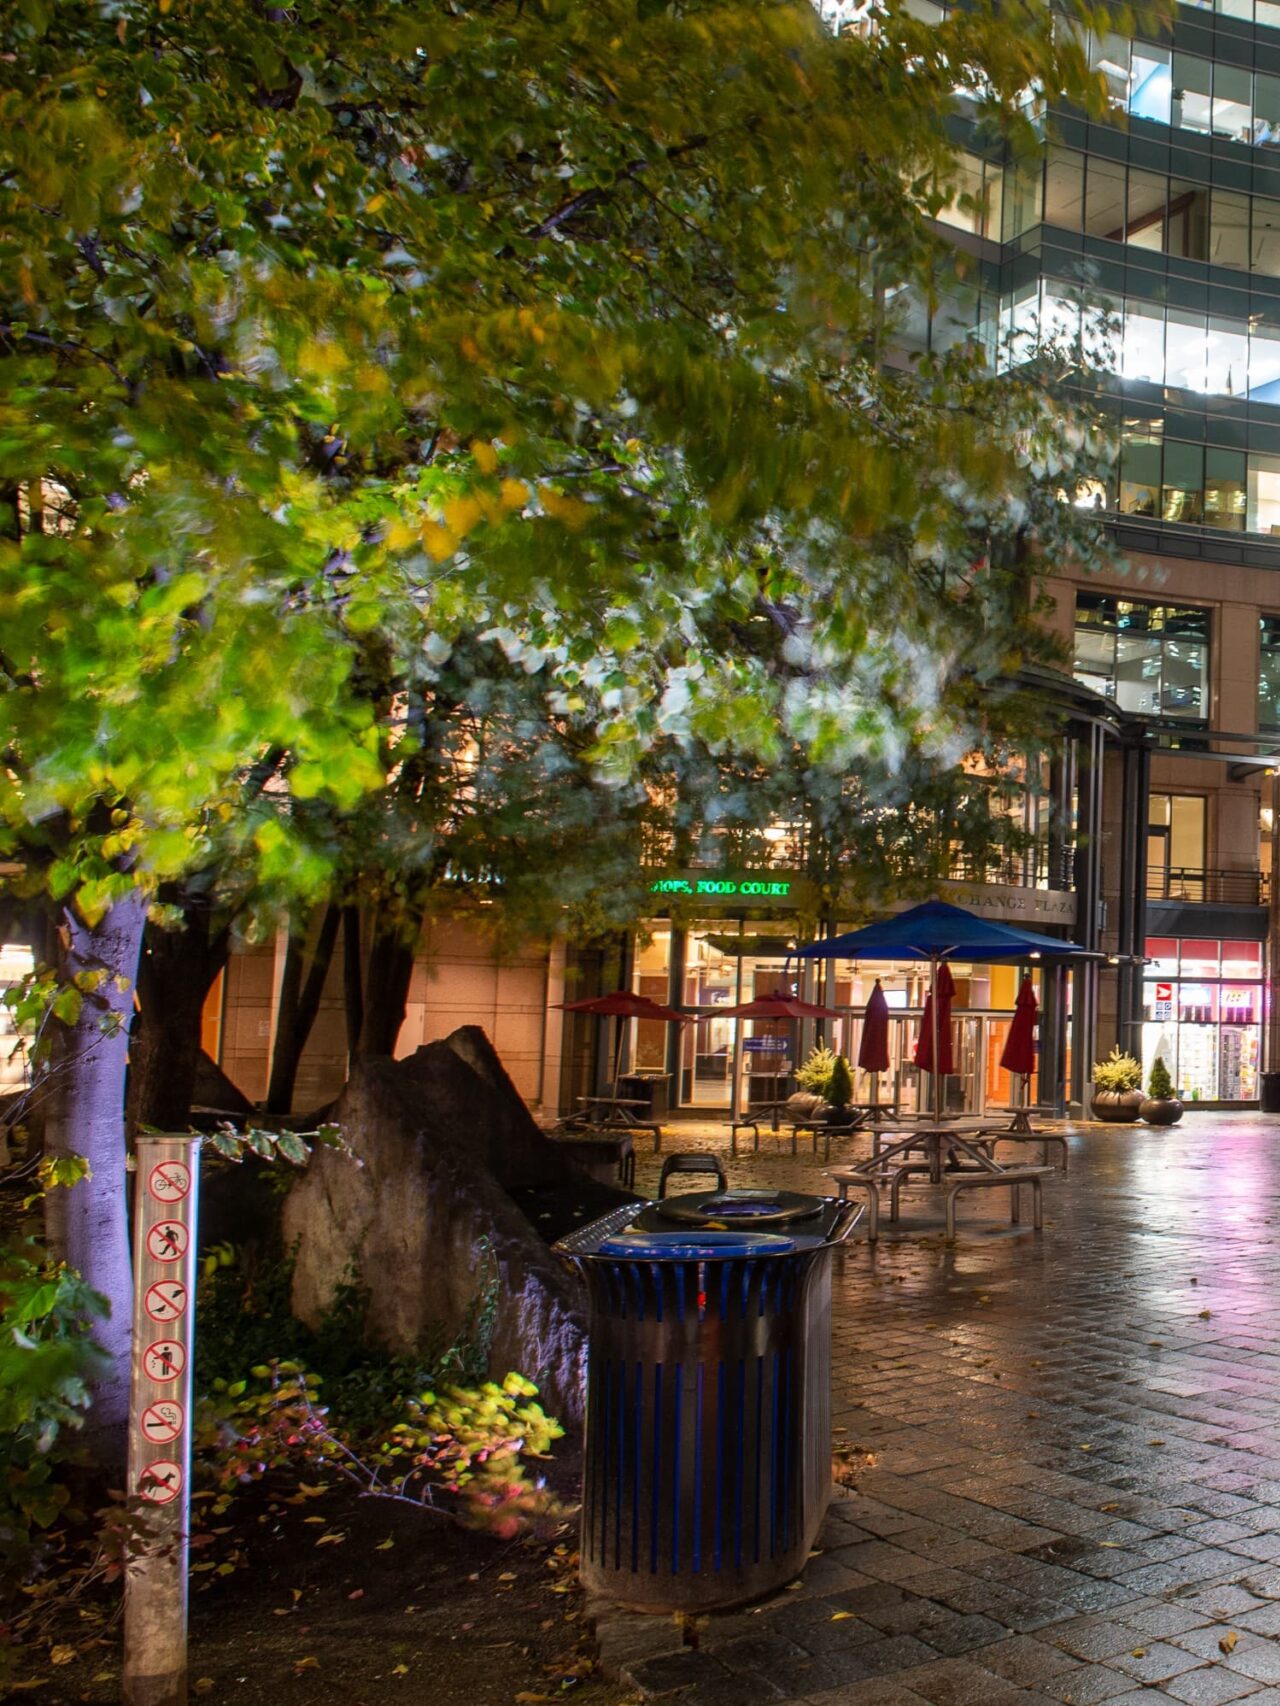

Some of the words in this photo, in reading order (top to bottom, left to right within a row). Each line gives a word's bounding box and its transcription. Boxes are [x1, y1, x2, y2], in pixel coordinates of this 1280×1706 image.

[650, 880, 693, 894] HOPS,
[697, 881, 736, 894] FOOD
[740, 883, 790, 895] COURT
[957, 894, 1026, 910] CHANGE
